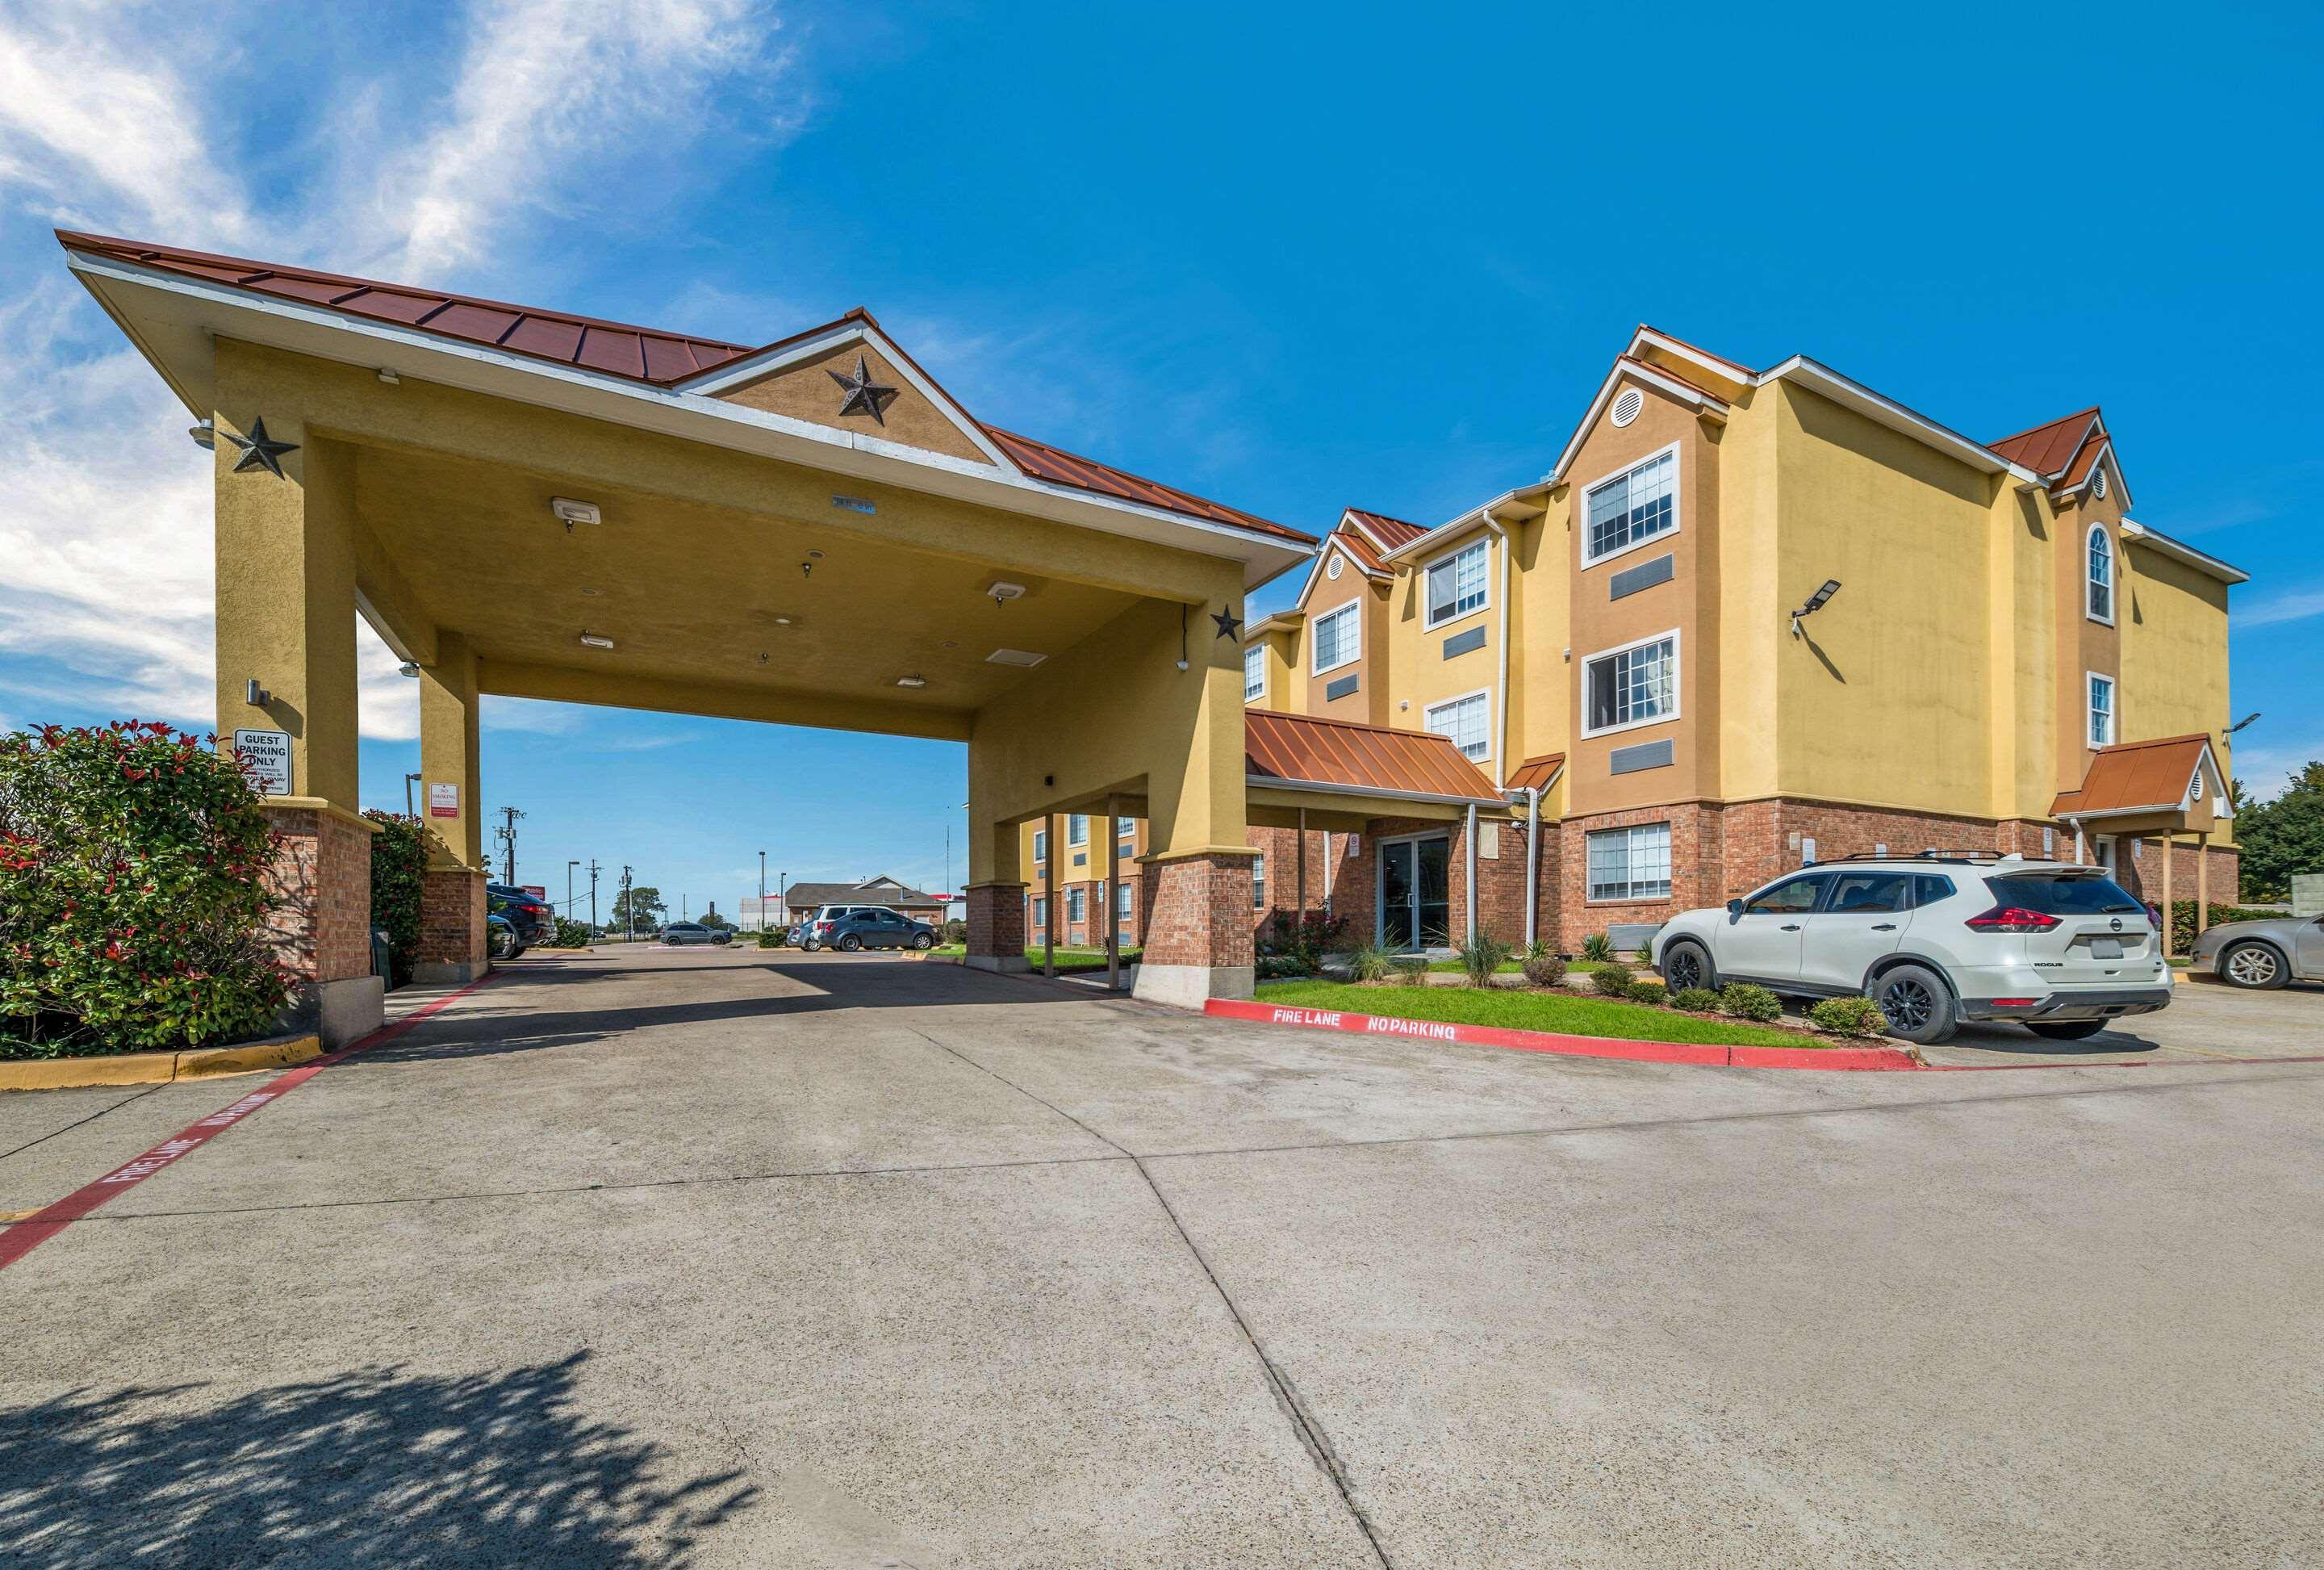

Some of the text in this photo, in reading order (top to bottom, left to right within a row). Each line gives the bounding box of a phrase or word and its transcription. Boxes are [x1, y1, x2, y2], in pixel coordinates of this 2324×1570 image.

[245, 735, 280, 744] GUEST
[240, 745, 286, 756] PARKING
[249, 757, 276, 765] ONLY
[1273, 1009, 1455, 1040] FIRE LANE NO PARKING
[100, 1161, 168, 1183] FIRE
[142, 1138, 202, 1161] LANE
